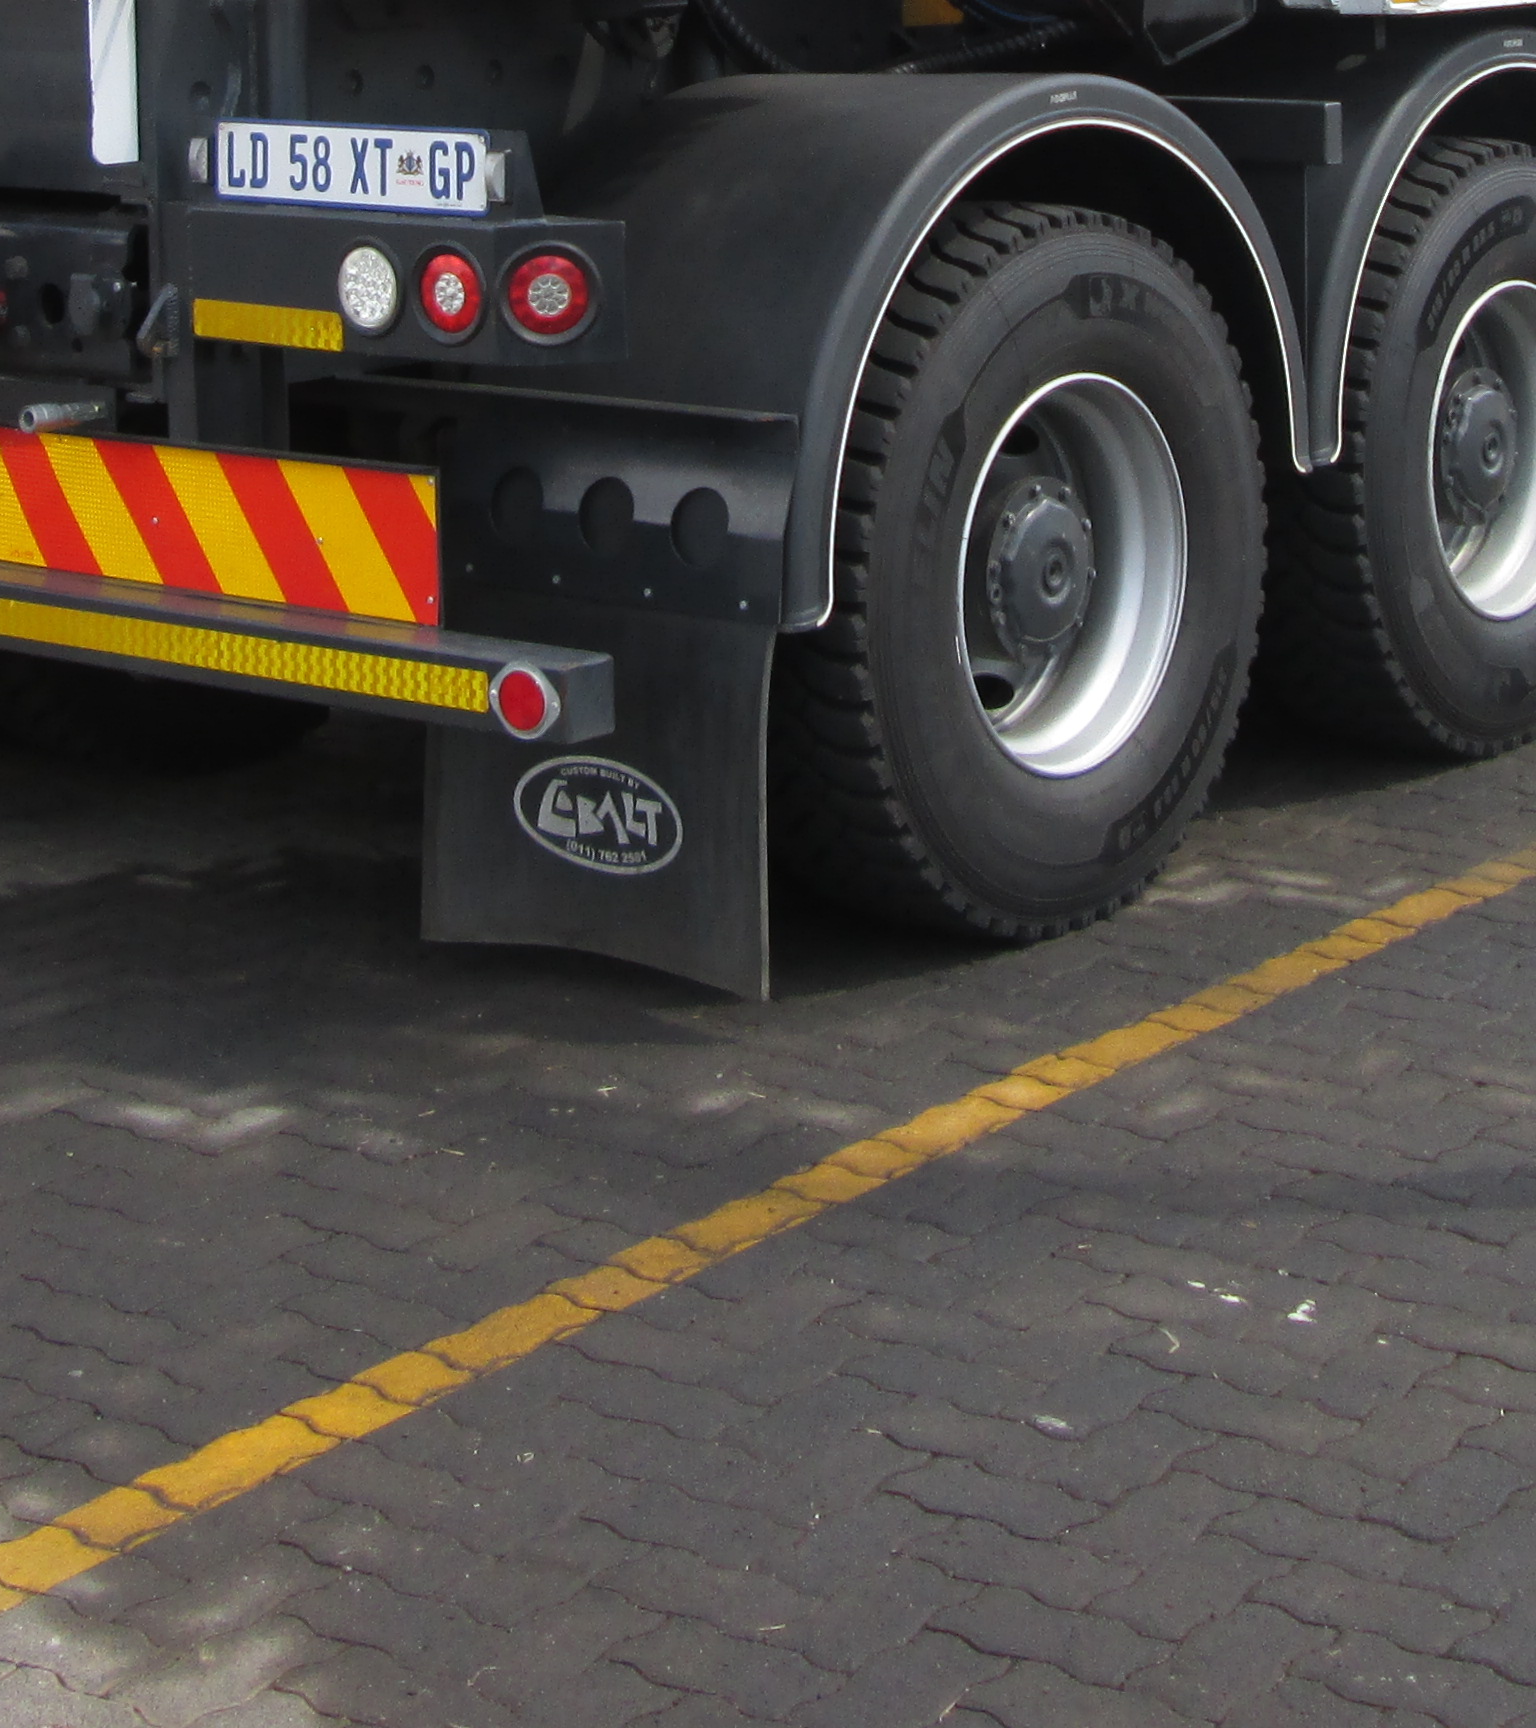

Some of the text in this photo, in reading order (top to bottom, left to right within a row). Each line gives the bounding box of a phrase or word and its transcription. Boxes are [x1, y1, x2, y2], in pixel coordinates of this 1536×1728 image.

[226, 130, 476, 201] LD 58 XT GP
[566, 838, 596, 862] (011)
